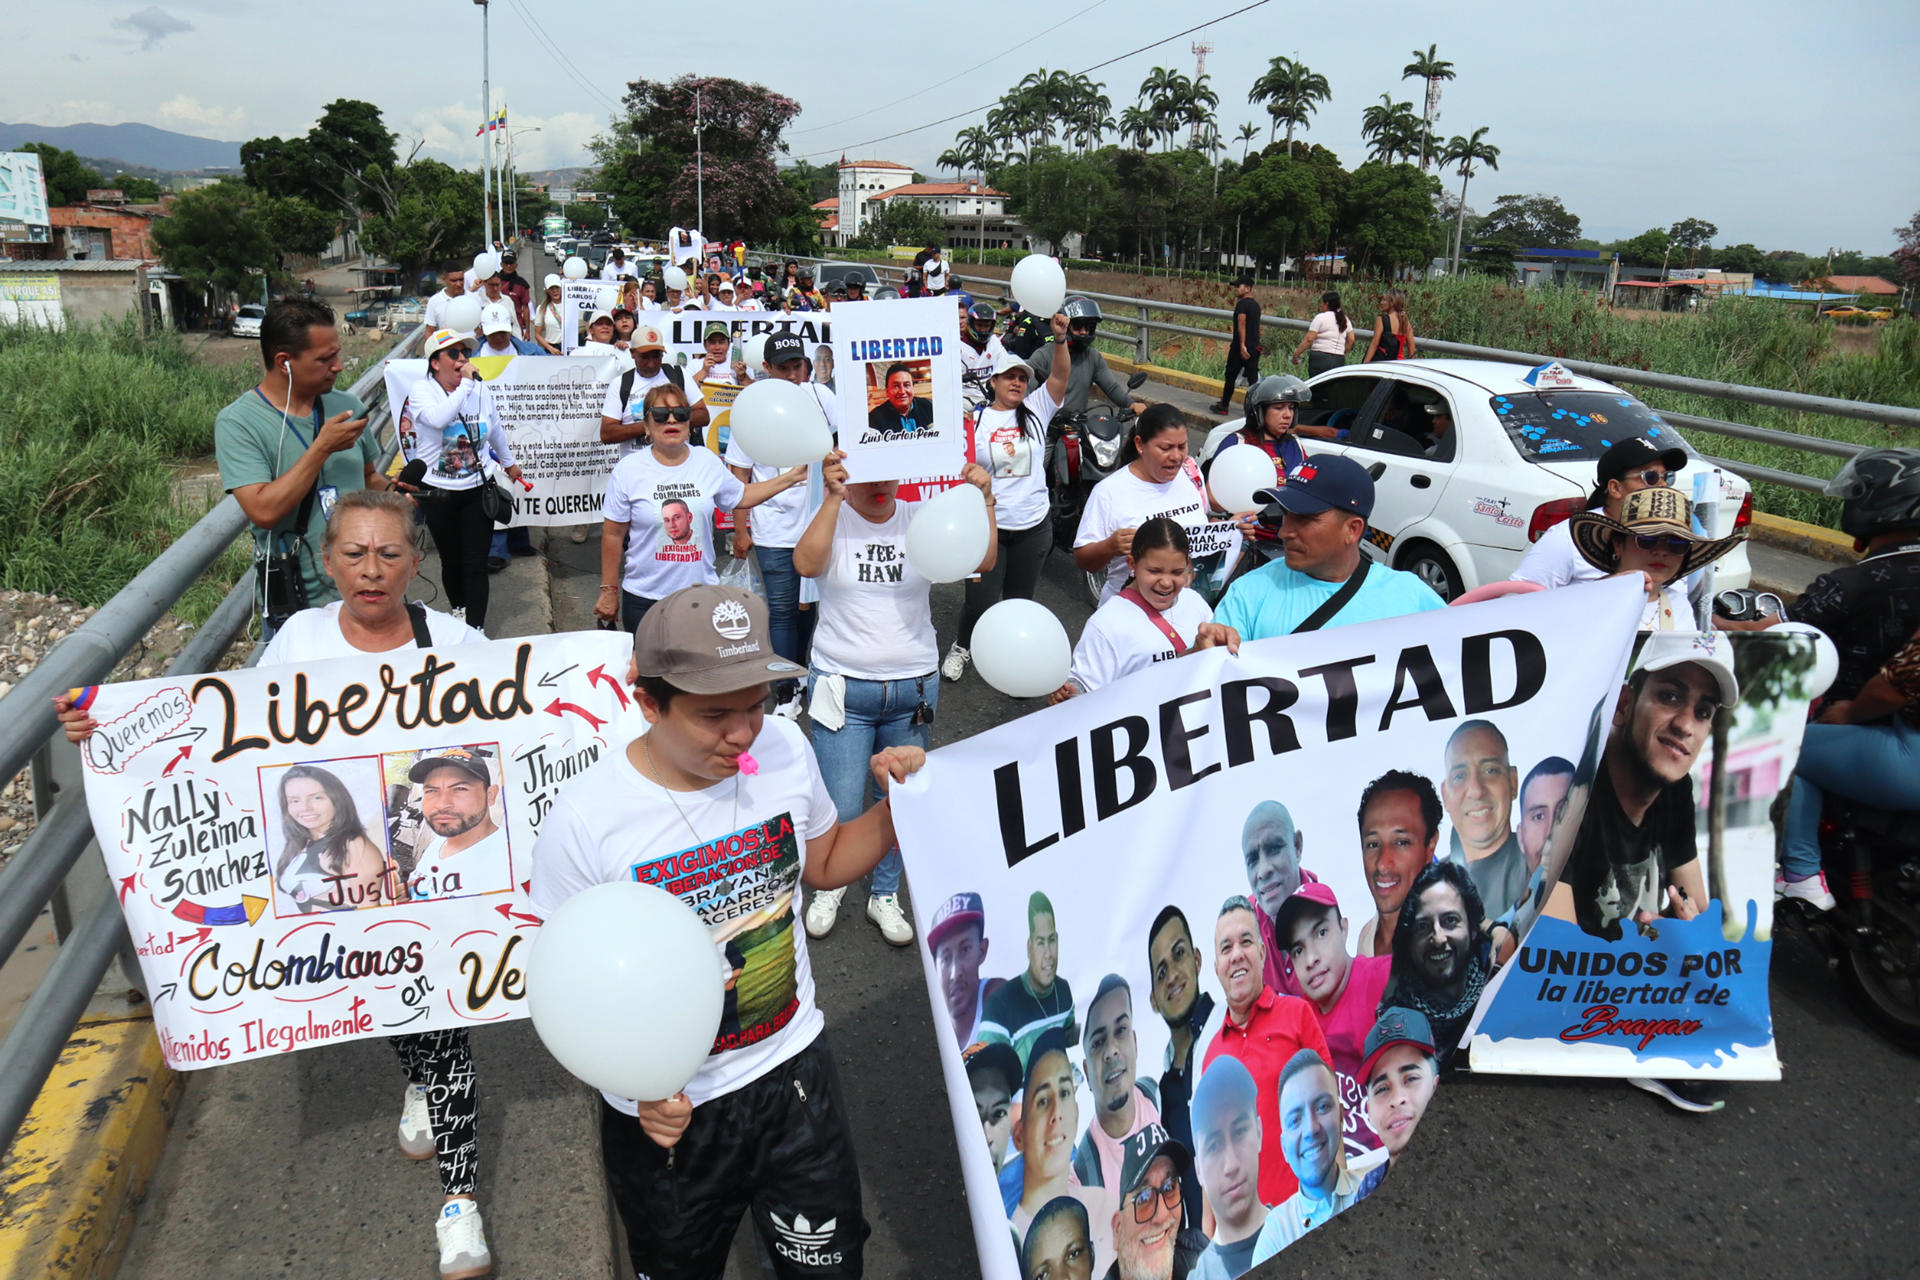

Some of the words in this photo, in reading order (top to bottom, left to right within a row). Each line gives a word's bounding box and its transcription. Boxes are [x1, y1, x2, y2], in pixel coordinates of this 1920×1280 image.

[673, 320, 833, 344] LIERTA
[851, 336, 943, 361] LIBERTAD
[859, 432, 881, 445] Luis
[884, 429, 914, 442] Carlos
[653, 489, 701, 500] COLMENARES
[656, 483, 678, 492] EDWIN
[679, 482, 695, 491] IVAN
[524, 497, 540, 515] TE
[545, 492, 606, 515] QUEREM
[1146, 503, 1200, 521] LIBERTAD
[1204, 523, 1236, 534] PARA
[655, 551, 691, 563] LIBERTAD
[865, 544, 896, 563] YEE
[1188, 540, 1232, 554] BURGOS
[858, 563, 904, 583] HAW
[715, 640, 760, 659] Timberland
[1152, 649, 1178, 663] LIB
[191, 643, 534, 763] Libertad
[87, 695, 186, 772] Queremos
[993, 628, 1547, 869] LIBERTAD
[150, 815, 257, 869] Zuleima
[635, 829, 761, 885] EXIGIMOS
[762, 817, 794, 844] LA
[321, 860, 463, 907] Justicia
[656, 853, 760, 897] IBERACION
[760, 843, 783, 864] DE
[696, 878, 782, 917] AVARRO
[703, 893, 776, 926] ACERES
[188, 932, 425, 1001] Colombianos
[459, 934, 527, 1012] Ve
[1518, 946, 1669, 977] UNIDOS
[1679, 948, 1743, 979] POR
[401, 975, 435, 1007] en
[1537, 978, 1568, 1003] la
[1572, 980, 1692, 1005] libertad
[1694, 982, 1731, 1006] de
[239, 994, 375, 1054] Ilegalmente
[739, 1020, 772, 1047] PARA
[1559, 1004, 1704, 1051] Brayan
[775, 1241, 843, 1266] adidas
